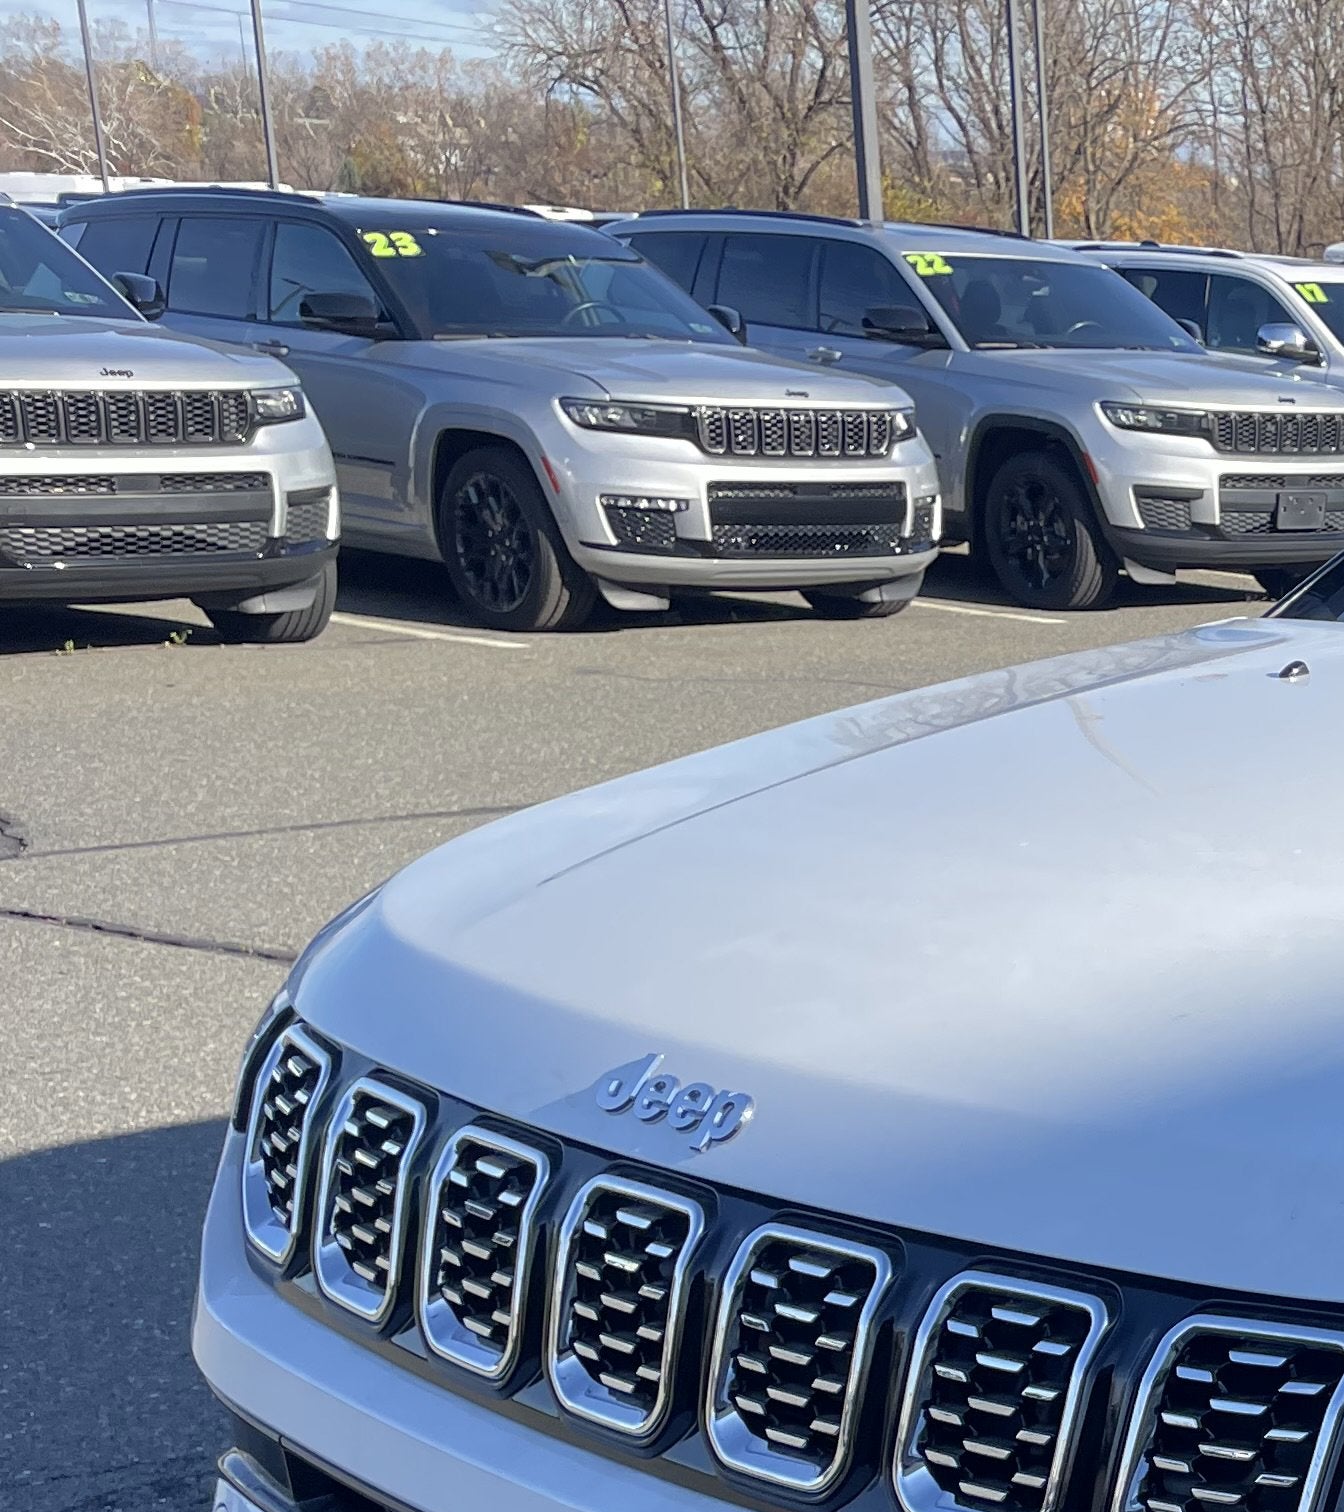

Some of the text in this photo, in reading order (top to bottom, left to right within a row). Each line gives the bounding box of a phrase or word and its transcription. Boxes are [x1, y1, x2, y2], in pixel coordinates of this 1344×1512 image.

[363, 231, 422, 257] 23
[905, 253, 954, 275] 22
[1294, 283, 1329, 303] 17
[99, 367, 134, 378] Jeep
[595, 1053, 754, 1152] Jeep
